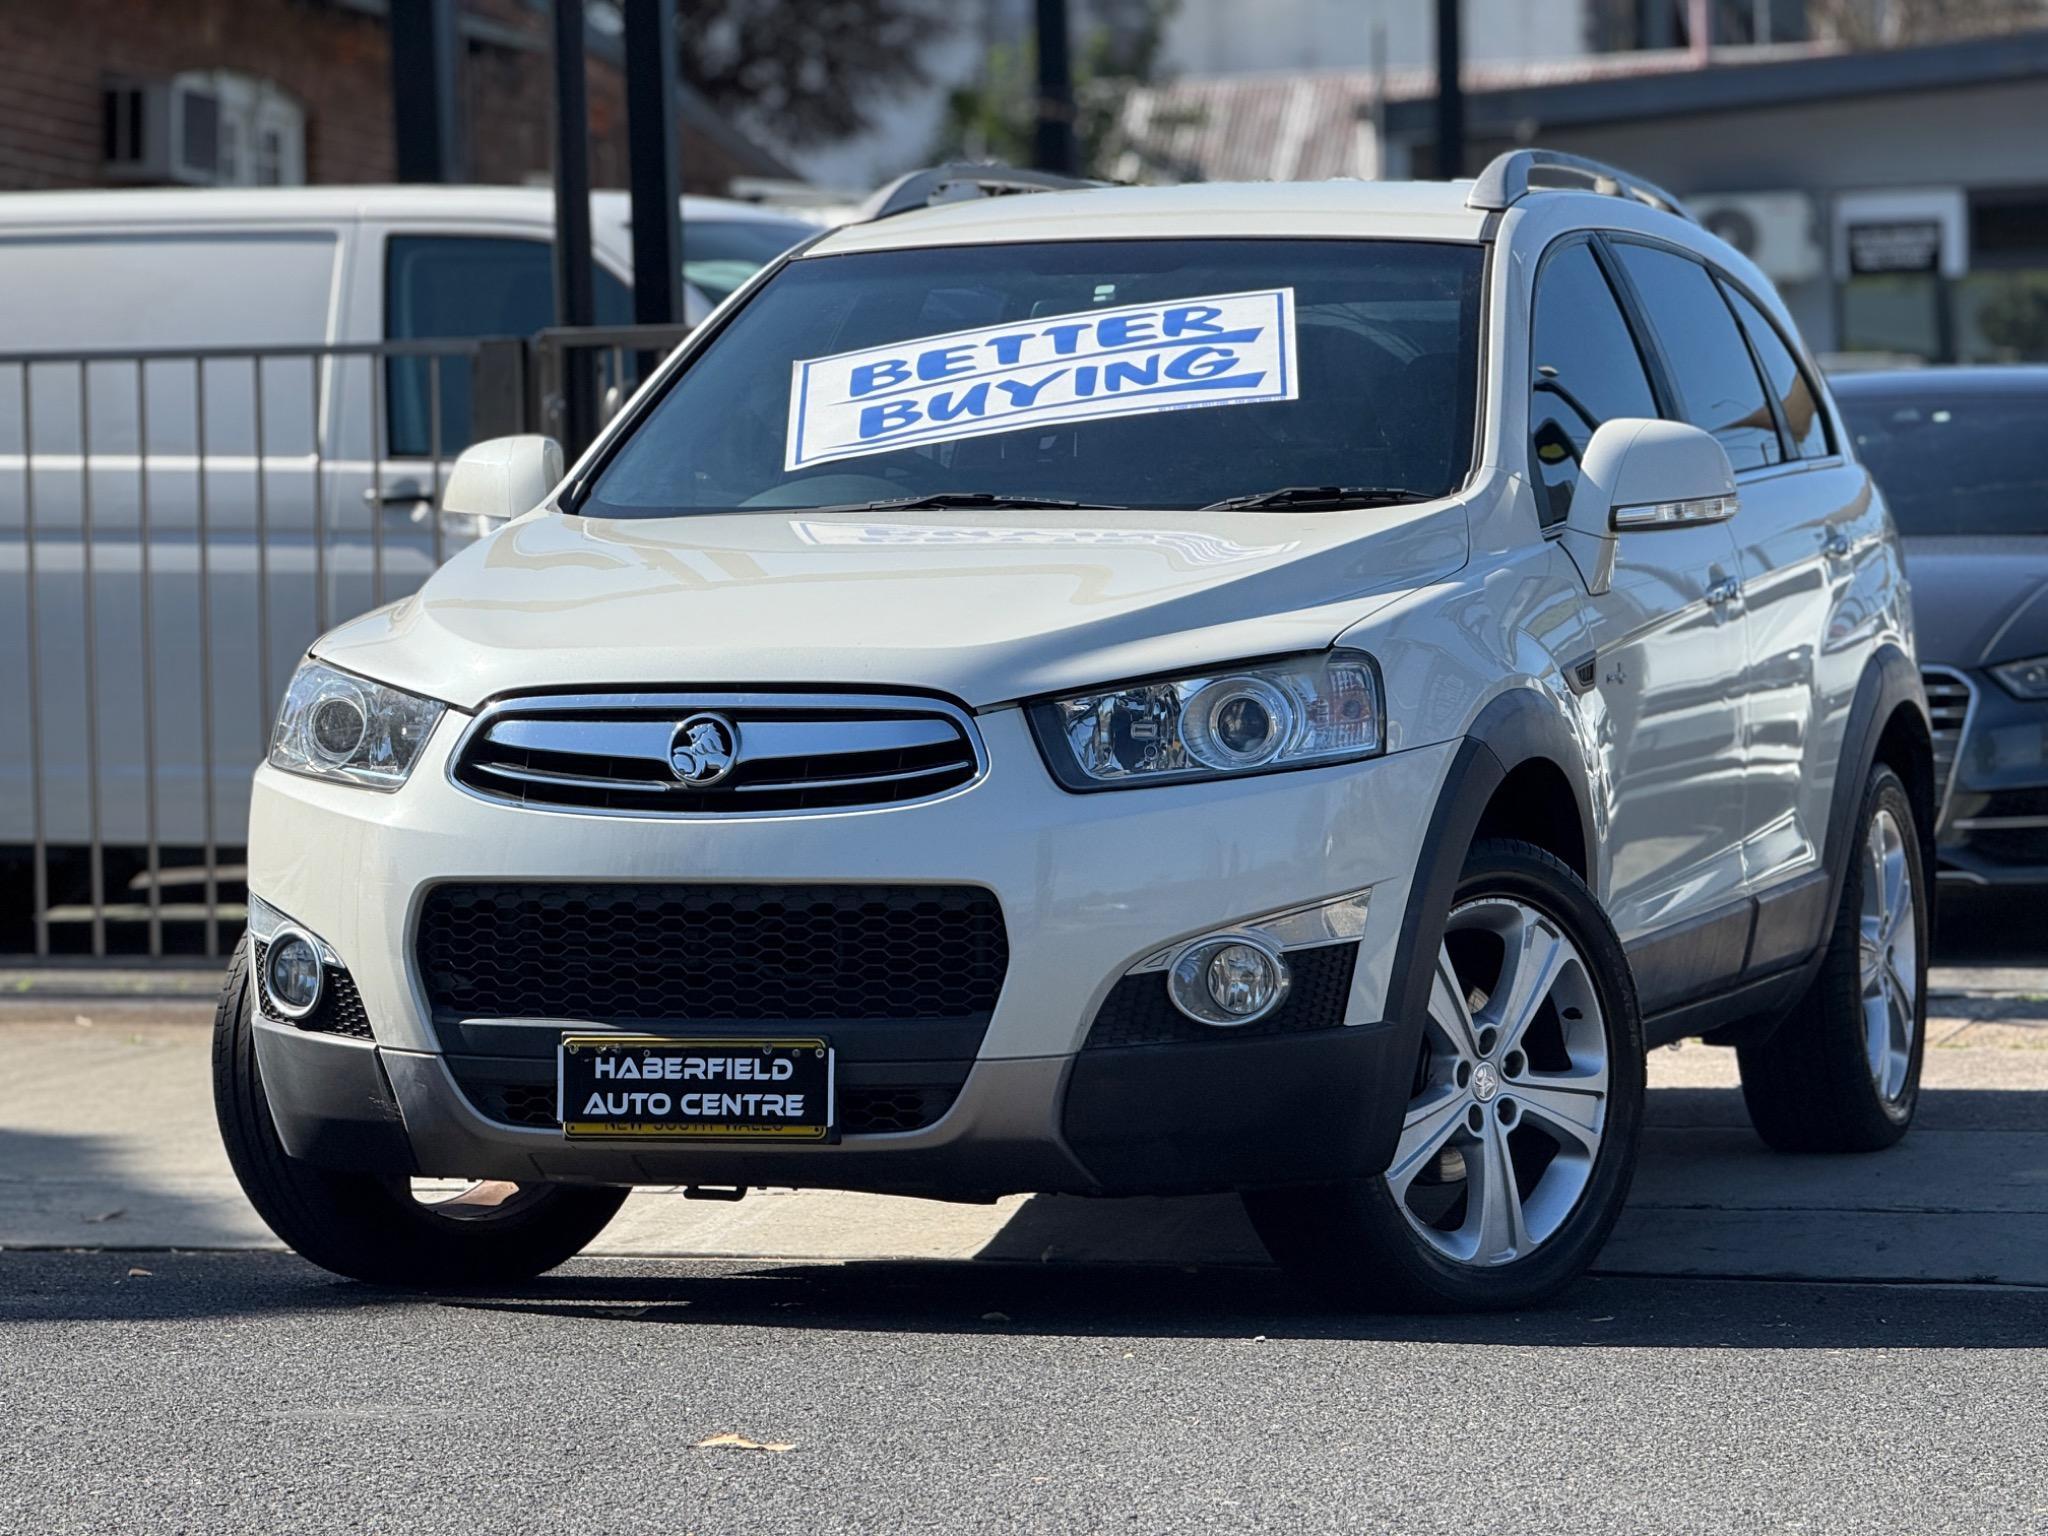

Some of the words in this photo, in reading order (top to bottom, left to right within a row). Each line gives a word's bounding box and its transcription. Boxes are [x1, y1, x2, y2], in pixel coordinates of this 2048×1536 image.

[849, 306, 1224, 397] BETTER
[859, 346, 1241, 439] BUYING
[594, 1057, 794, 1081] HABERFIELD
[583, 1092, 672, 1116] AUTO
[680, 1093, 805, 1117] CENTRE
